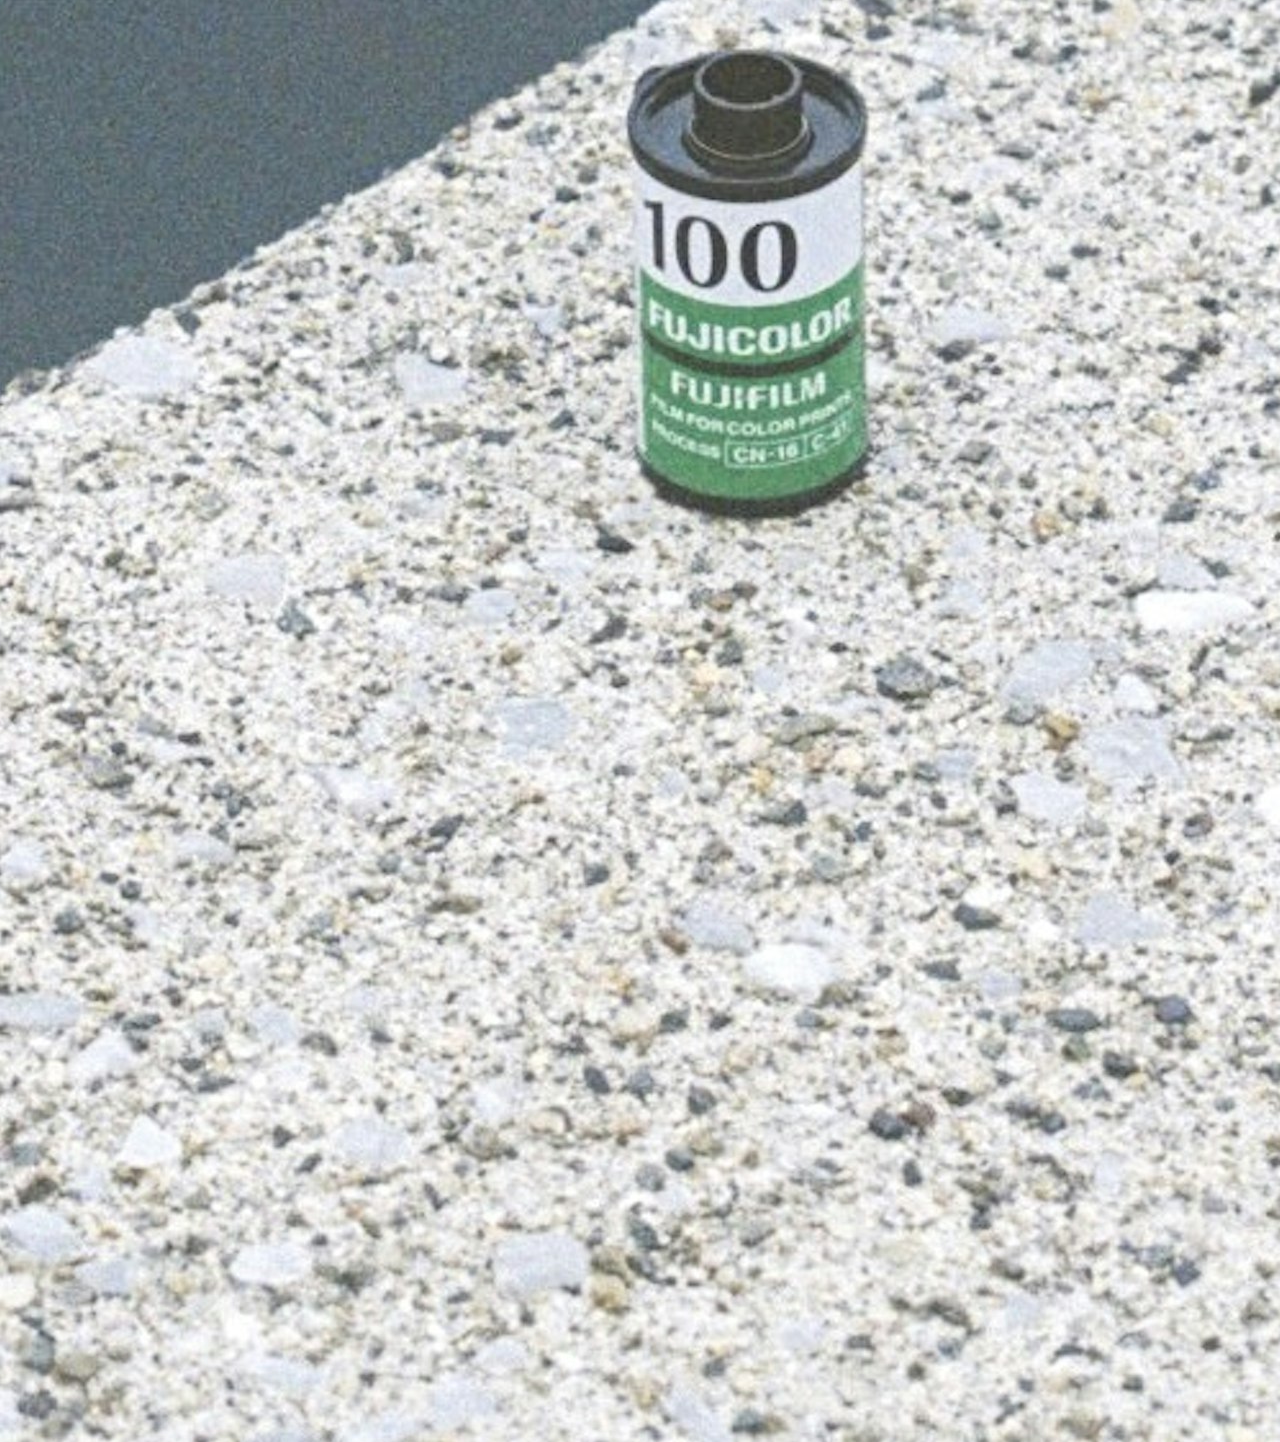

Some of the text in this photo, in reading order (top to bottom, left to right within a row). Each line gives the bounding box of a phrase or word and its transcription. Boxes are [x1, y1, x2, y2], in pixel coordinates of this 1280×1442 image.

[644, 200, 797, 292] 100
[649, 296, 852, 356] FUJICOLOR
[671, 369, 827, 410] FUJIFILM
[651, 418, 721, 459] PROCESS
[733, 443, 799, 464] CN-16
[686, 413, 724, 434] FOR
[726, 419, 796, 437] COLOR
